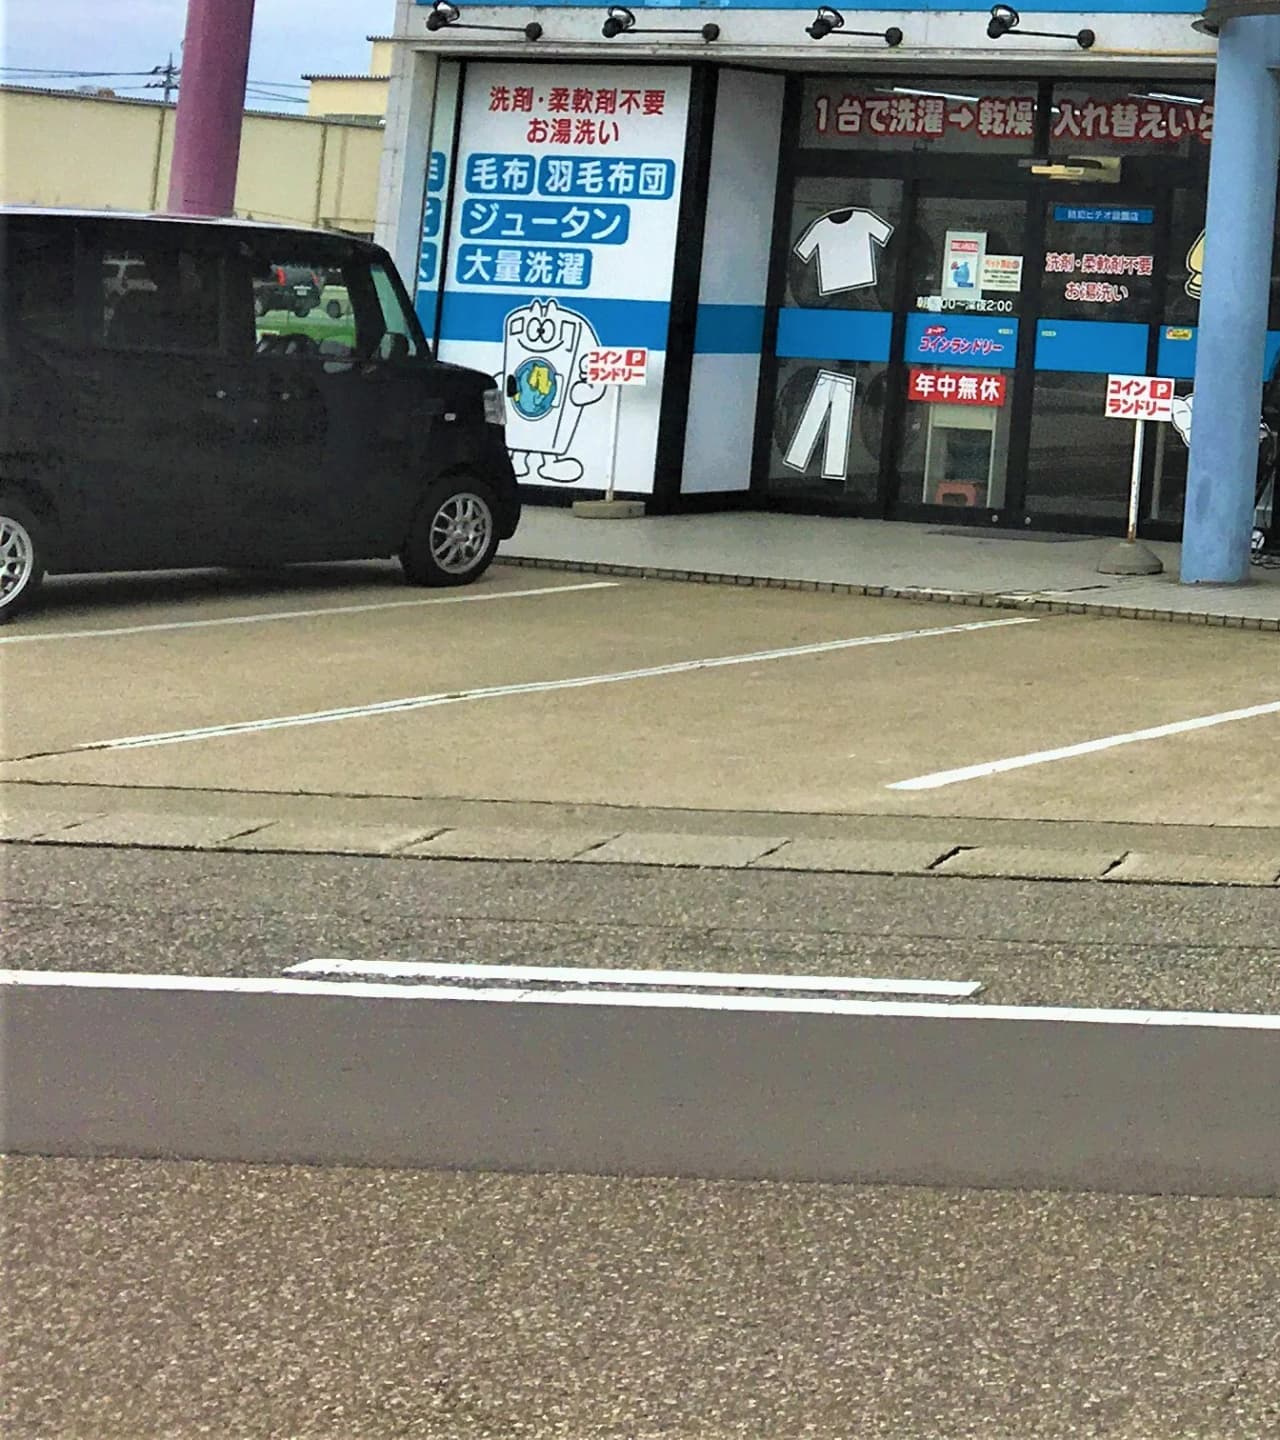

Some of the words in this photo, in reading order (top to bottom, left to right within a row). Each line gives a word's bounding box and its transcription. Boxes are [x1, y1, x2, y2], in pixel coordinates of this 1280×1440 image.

[488, 85, 666, 116] 洗剤・柔軟剤不要
[526, 117, 620, 145] お湯洗い
[470, 157, 532, 193] 毛布
[543, 162, 669, 198] 羽毛布団
[468, 204, 621, 240] ジュータン
[462, 251, 586, 286] 大量洗濯
[1045, 252, 1154, 276] 洗剤・柔軟剤不要
[1065, 281, 1129, 303] お湯洗い
[589, 350, 622, 365] コイン
[918, 336, 1005, 356] コインランドリー
[588, 367, 645, 382] ランドリー
[914, 373, 1001, 401] 年中無休
[1109, 379, 1147, 397] コイン
[1108, 398, 1171, 417] ランドリー
